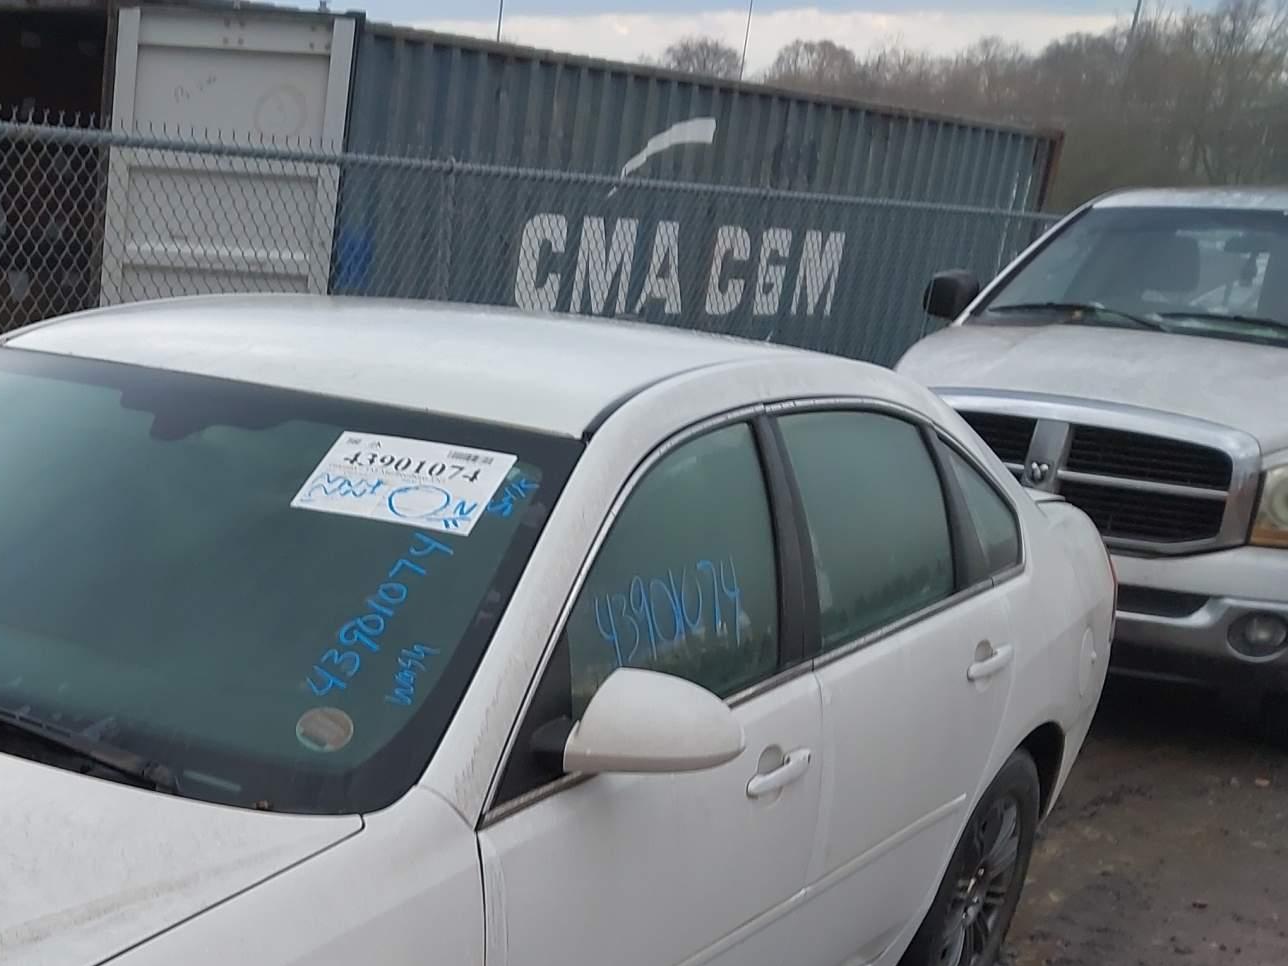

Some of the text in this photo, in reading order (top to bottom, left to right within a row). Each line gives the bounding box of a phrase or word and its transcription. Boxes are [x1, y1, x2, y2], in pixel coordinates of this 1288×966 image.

[514, 213, 846, 316] CMA CGM
[344, 451, 481, 483] 43901074
[305, 531, 455, 696] 43901074
[594, 554, 742, 668] 43901074
